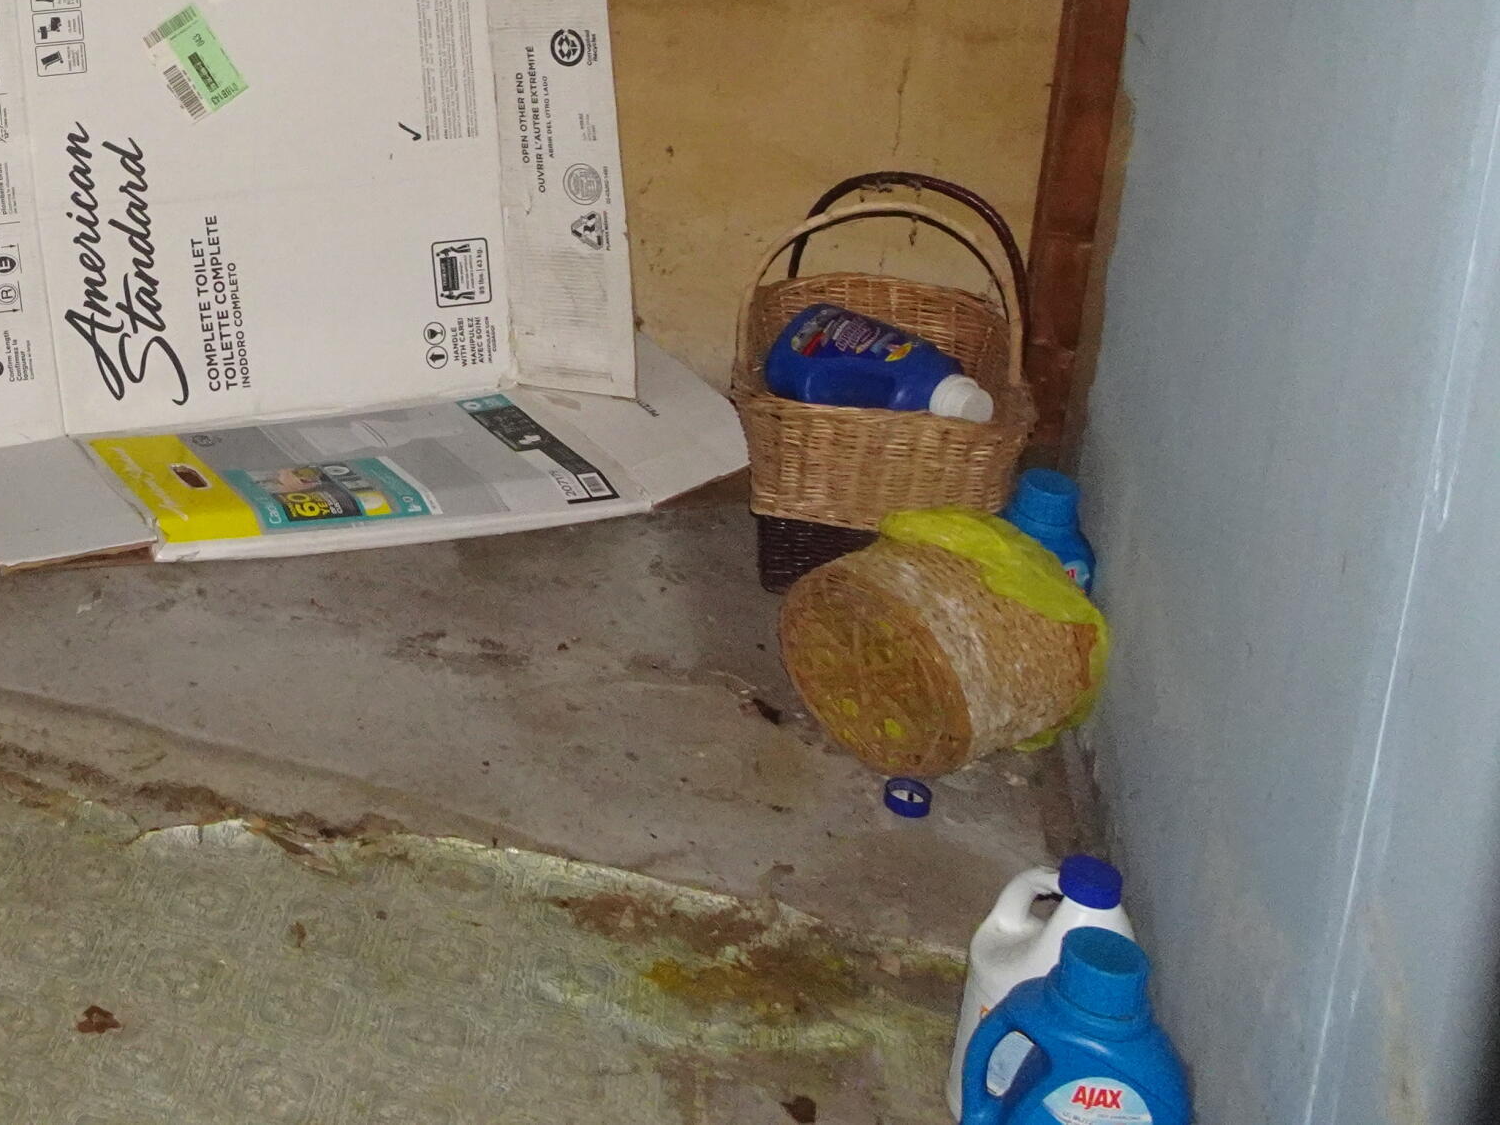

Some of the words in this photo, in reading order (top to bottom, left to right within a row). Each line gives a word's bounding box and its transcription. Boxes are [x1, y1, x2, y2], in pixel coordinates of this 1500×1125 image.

[515, 71, 525, 93] END
[525, 44, 538, 103] EXTRÉMITÉ
[517, 96, 528, 131] OTHER
[532, 105, 543, 149] L'AUTRE
[521, 134, 531, 163] OPEN
[547, 134, 555, 158] ABRIR
[535, 152, 546, 192] OUVRIR
[64, 120, 125, 400] American
[101, 136, 189, 405] Standard
[190, 237, 208, 296] TOILET
[205, 214, 227, 303] COMPLETE
[226, 261, 244, 326] COMPLETO
[3, 329, 11, 353] Length
[199, 300, 222, 391] COMPLETE
[216, 308, 238, 389] TOILETTE
[451, 326, 460, 360] HANDLE
[457, 317, 465, 341] CARE!
[468, 316, 477, 364] MANIPULEZ
[7, 354, 15, 381] Confirm
[235, 329, 252, 388] INODORO
[1071, 1085, 1123, 1110] AJAX
